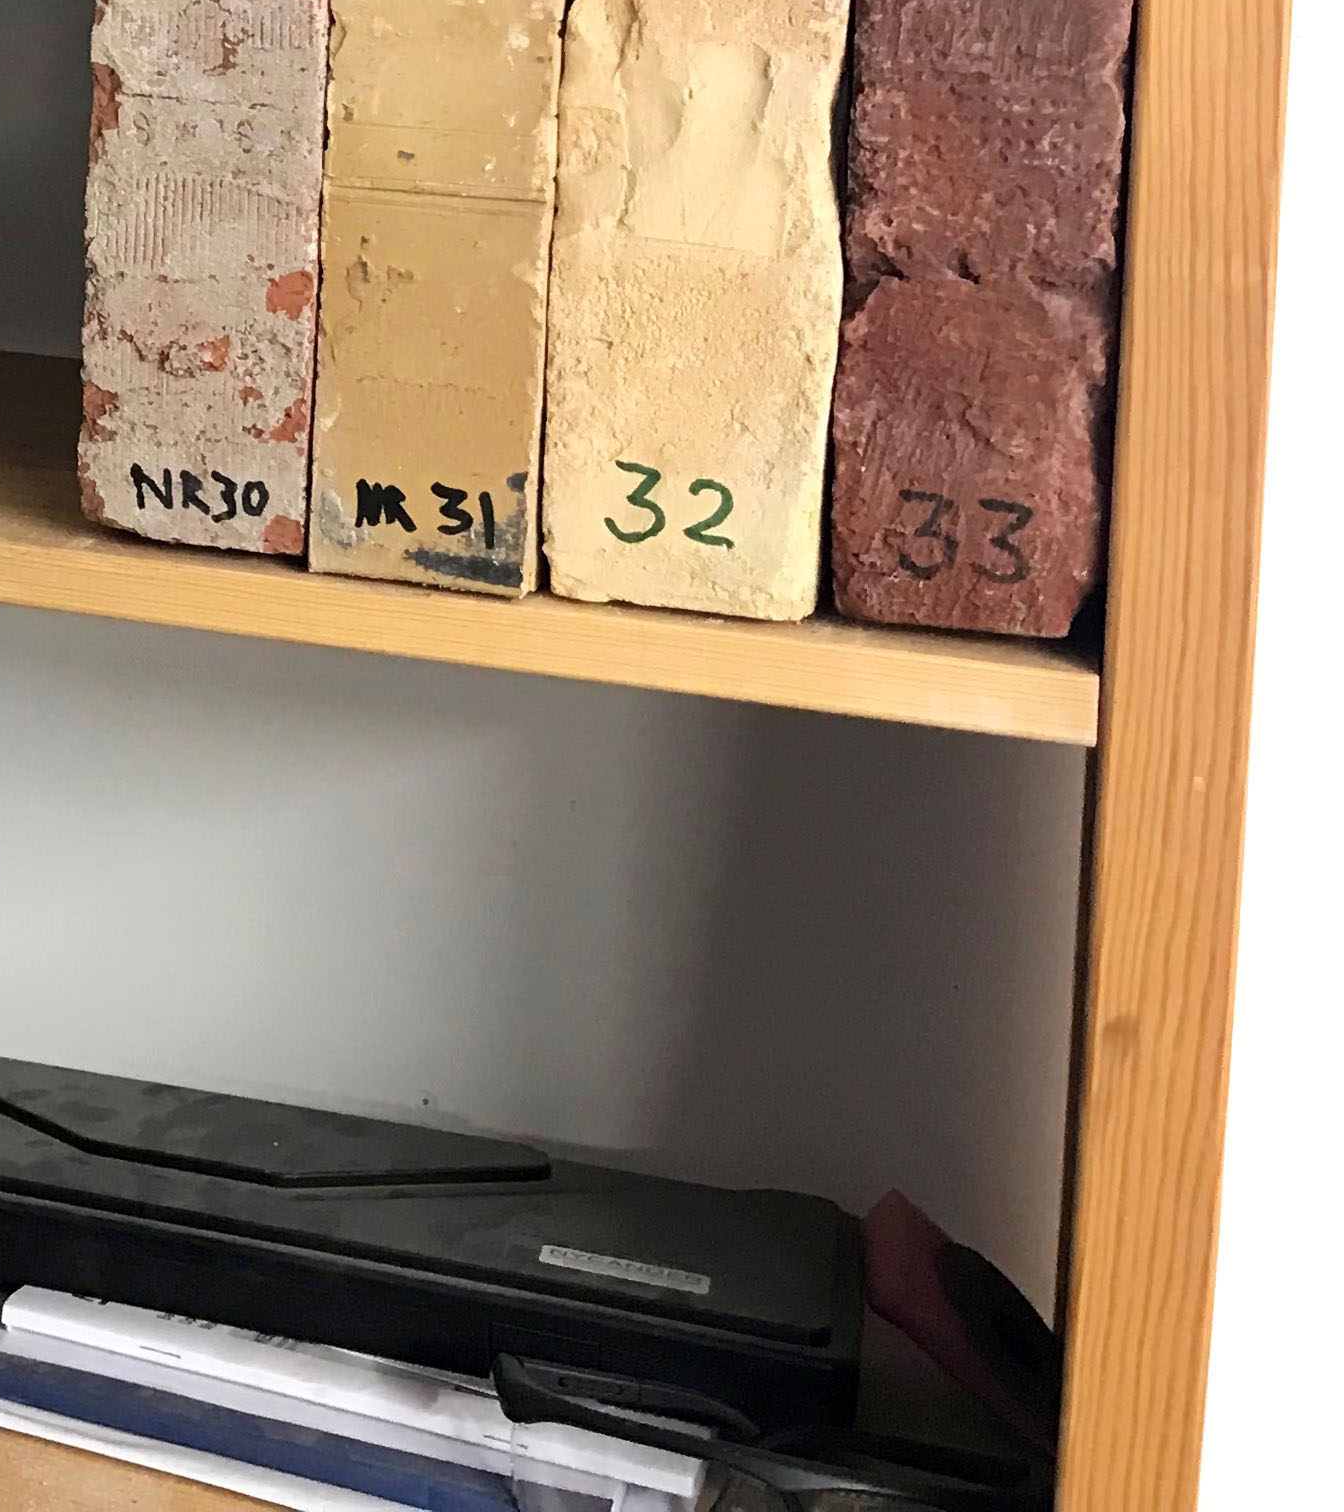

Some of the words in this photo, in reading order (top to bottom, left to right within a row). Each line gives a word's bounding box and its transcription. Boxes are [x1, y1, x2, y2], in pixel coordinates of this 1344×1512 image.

[355, 478, 417, 534] NR
[430, 482, 496, 550] 31
[603, 459, 736, 552] 32
[898, 489, 1041, 585] 33
